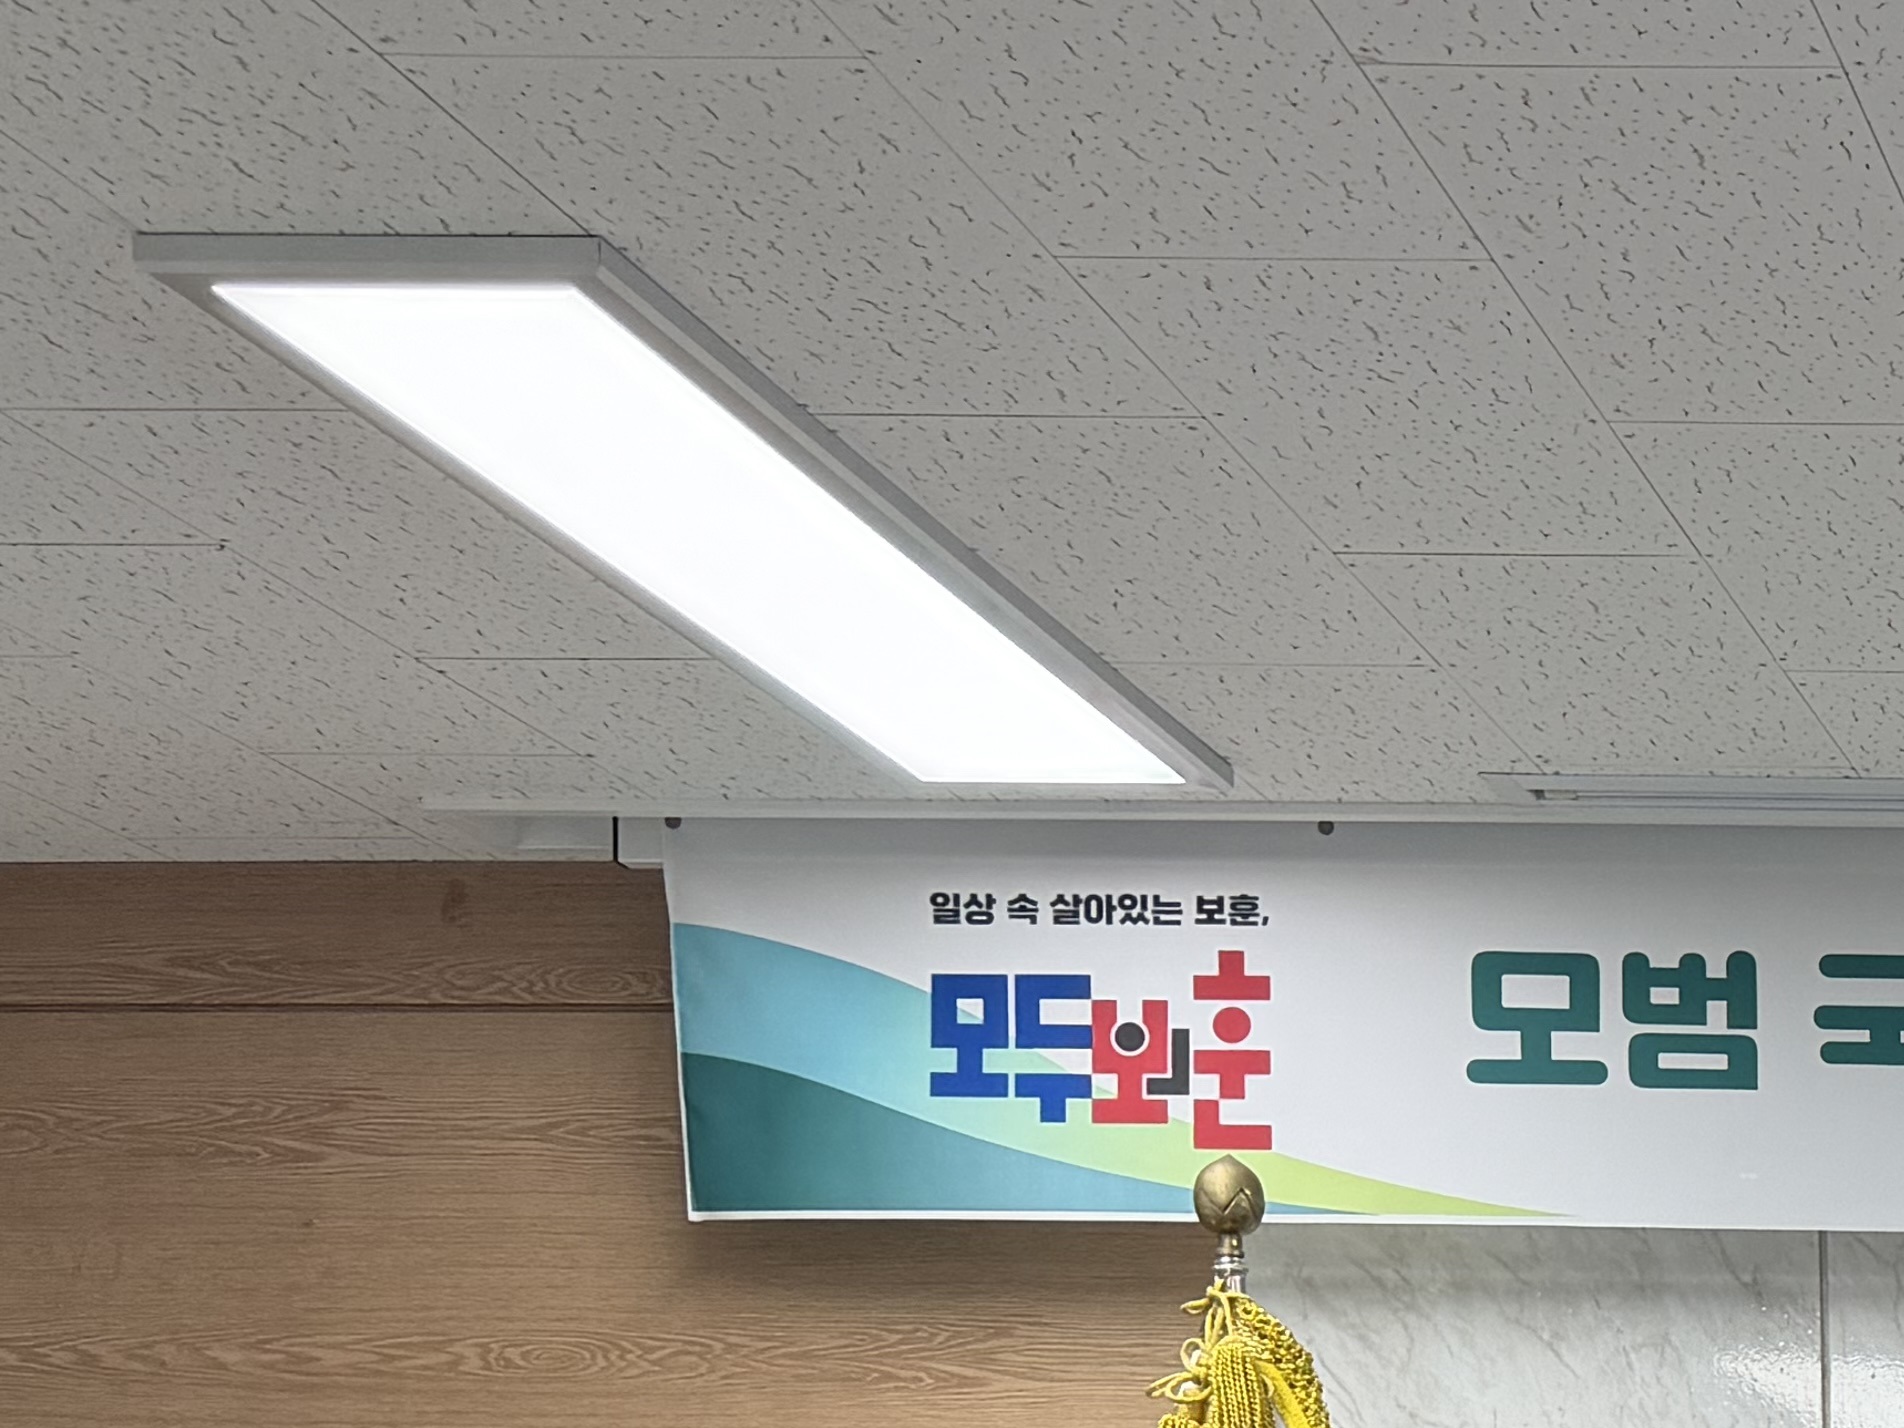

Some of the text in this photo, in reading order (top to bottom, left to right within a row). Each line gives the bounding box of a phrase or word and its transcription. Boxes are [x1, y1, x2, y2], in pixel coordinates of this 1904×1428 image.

[929, 891, 1269, 927] 일상 속 살아있는 보훈,
[1466, 950, 1759, 1091] 모범
